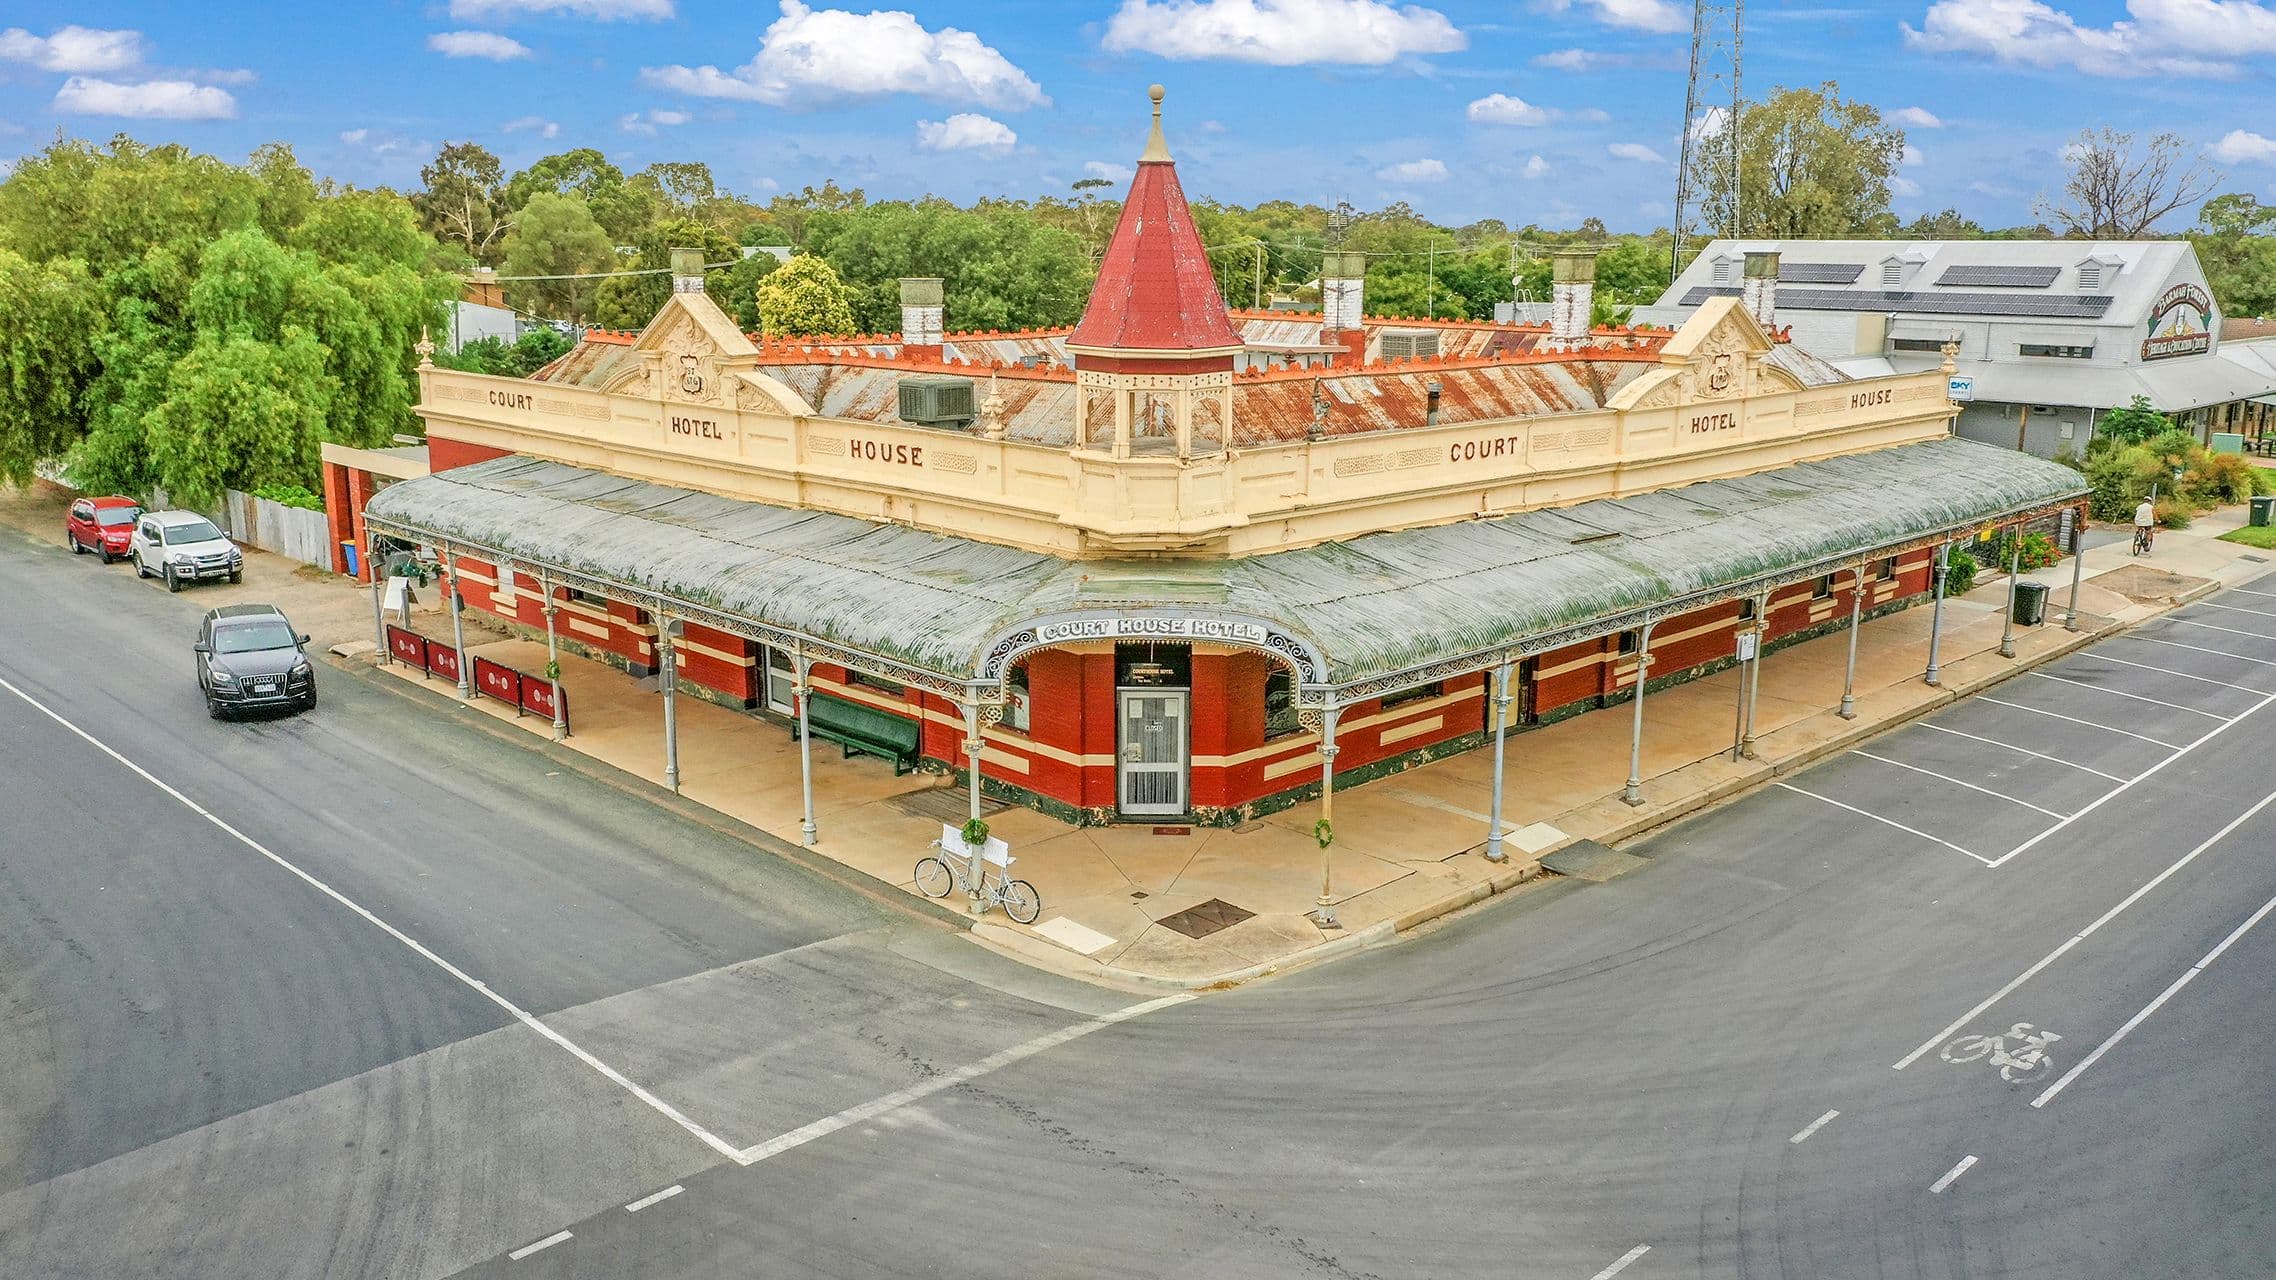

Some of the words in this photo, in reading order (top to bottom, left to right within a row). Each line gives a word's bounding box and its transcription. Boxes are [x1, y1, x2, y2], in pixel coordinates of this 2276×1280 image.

[1951, 381, 1970, 390] SKY
[489, 390, 532, 411] COURT
[1851, 389, 1892, 409] HOUSE
[672, 416, 722, 440] HOTEL
[1691, 413, 1736, 434] HOTEL
[850, 439, 923, 467] HOUSE
[1450, 436, 1518, 463] COURT
[1044, 620, 1109, 640] COURT
[1118, 619, 1186, 634] HOUSE
[1192, 620, 1261, 641] HOTEL
